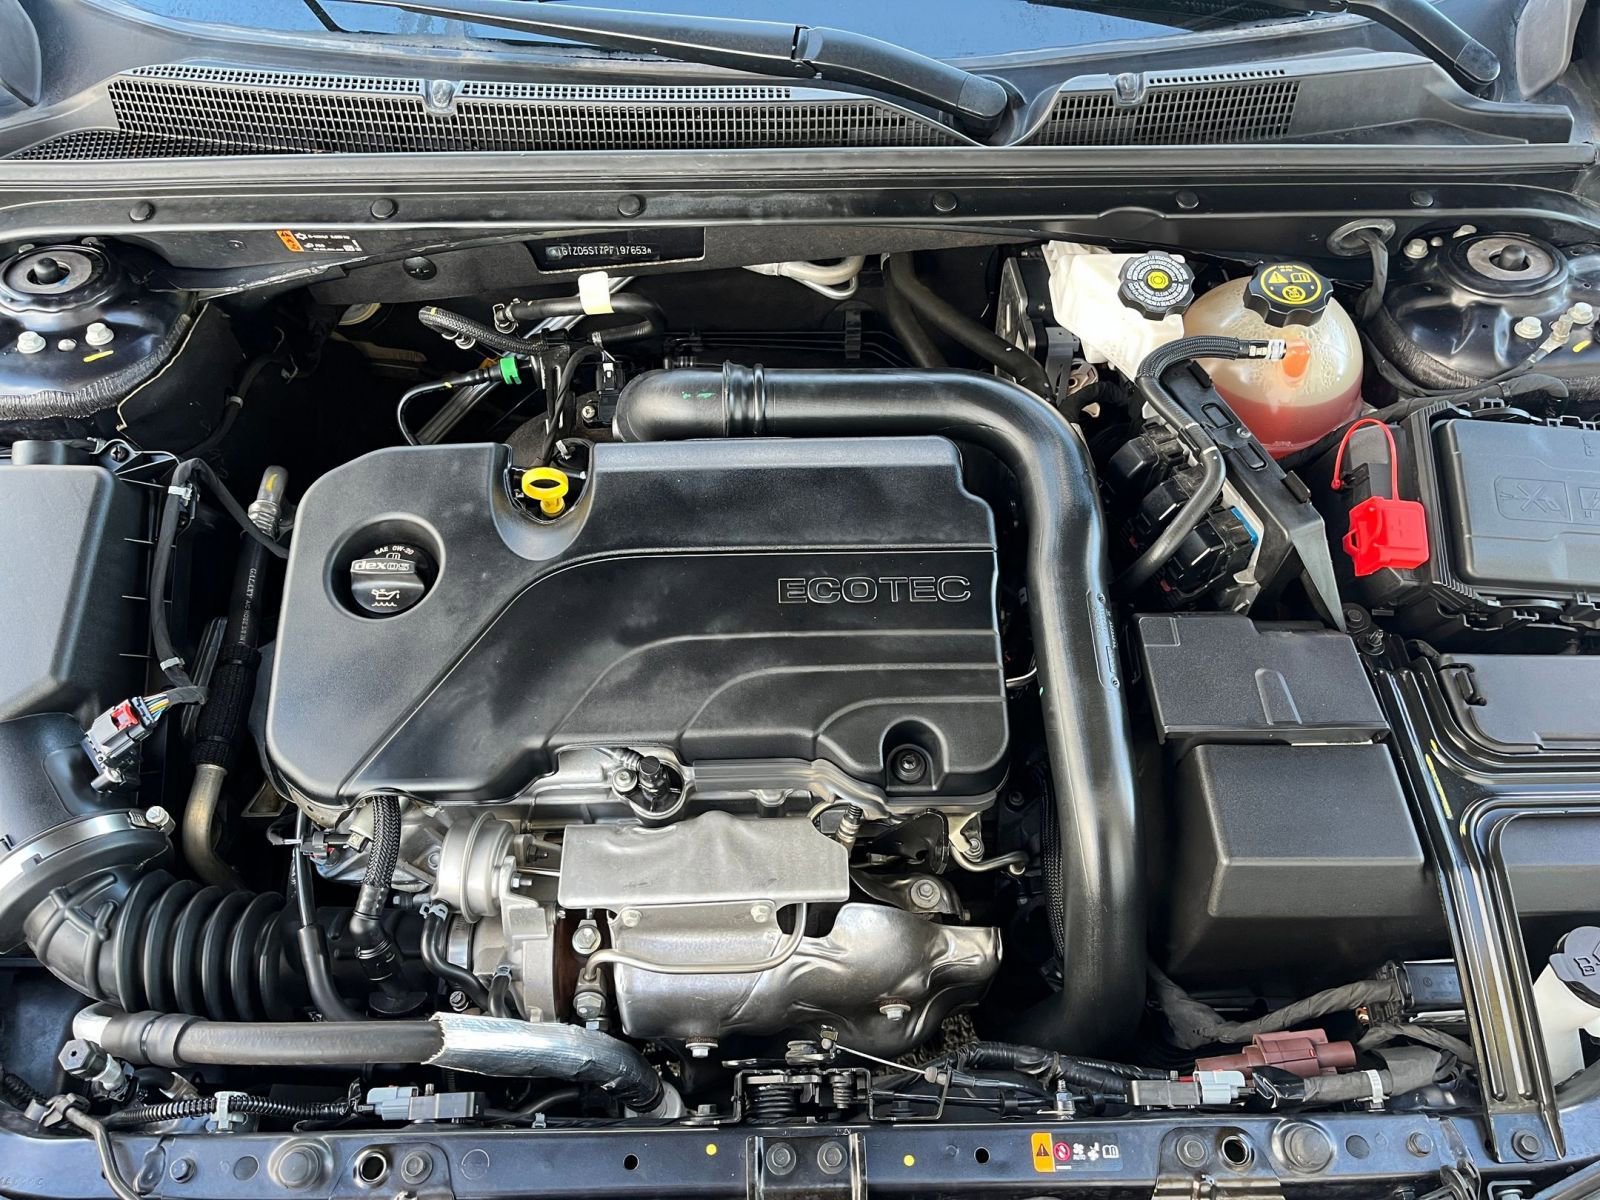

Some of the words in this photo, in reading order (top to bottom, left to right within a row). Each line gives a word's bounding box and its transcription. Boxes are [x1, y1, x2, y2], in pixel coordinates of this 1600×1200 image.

[374, 546, 389, 555] SAE
[392, 545, 415, 555] 0W-20
[354, 561, 410, 571] dexos
[246, 568, 257, 599] GALAXY
[777, 575, 972, 604] ECOTEC
